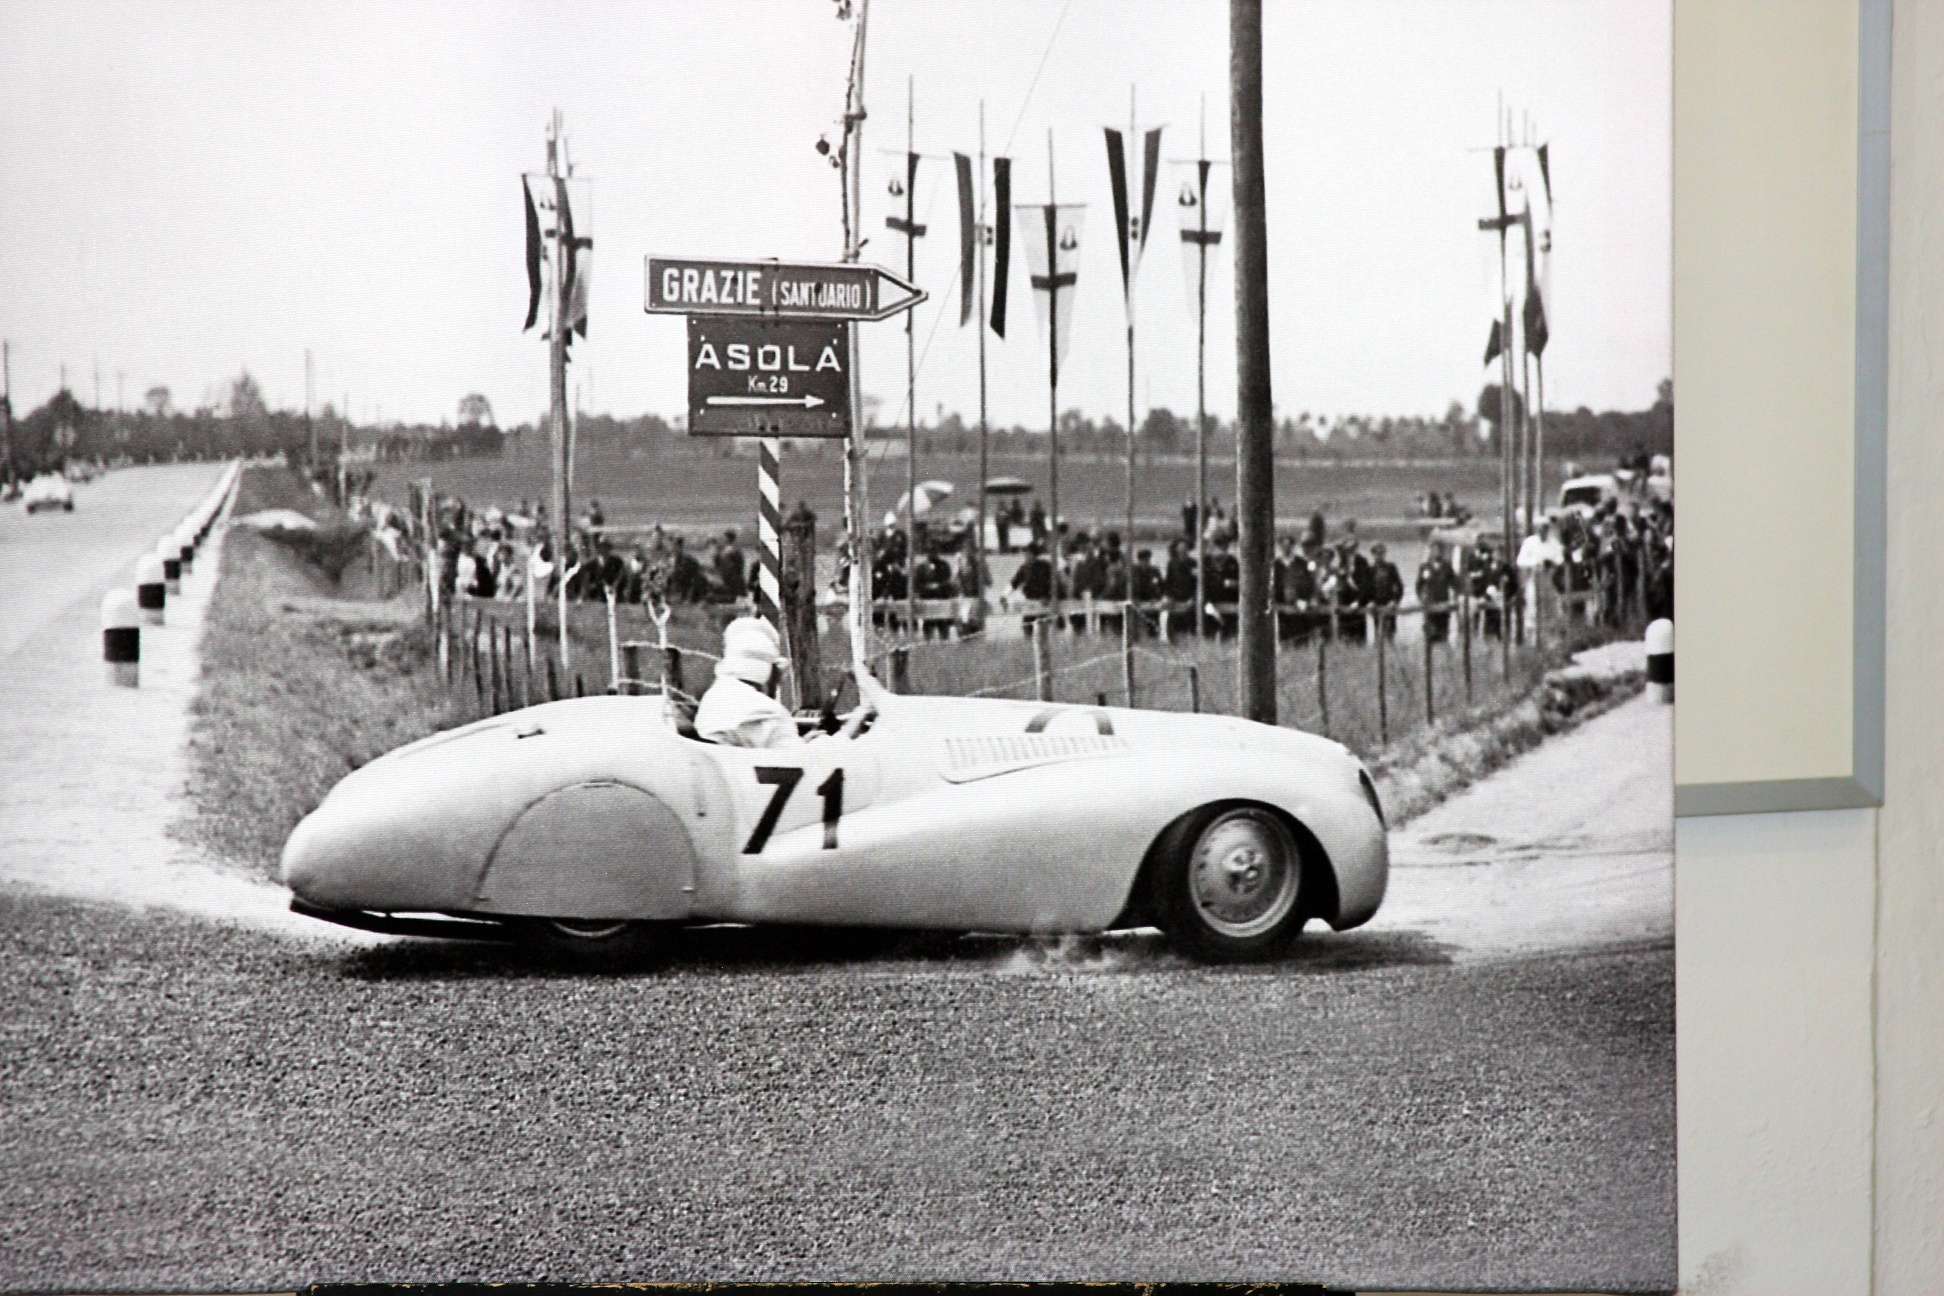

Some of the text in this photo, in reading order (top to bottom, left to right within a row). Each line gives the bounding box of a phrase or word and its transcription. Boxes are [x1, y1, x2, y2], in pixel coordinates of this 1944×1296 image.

[662, 268, 762, 304] GRAZIE
[695, 343, 842, 372] ASOLA
[769, 375, 788, 393] 29
[741, 766, 845, 854] 71
